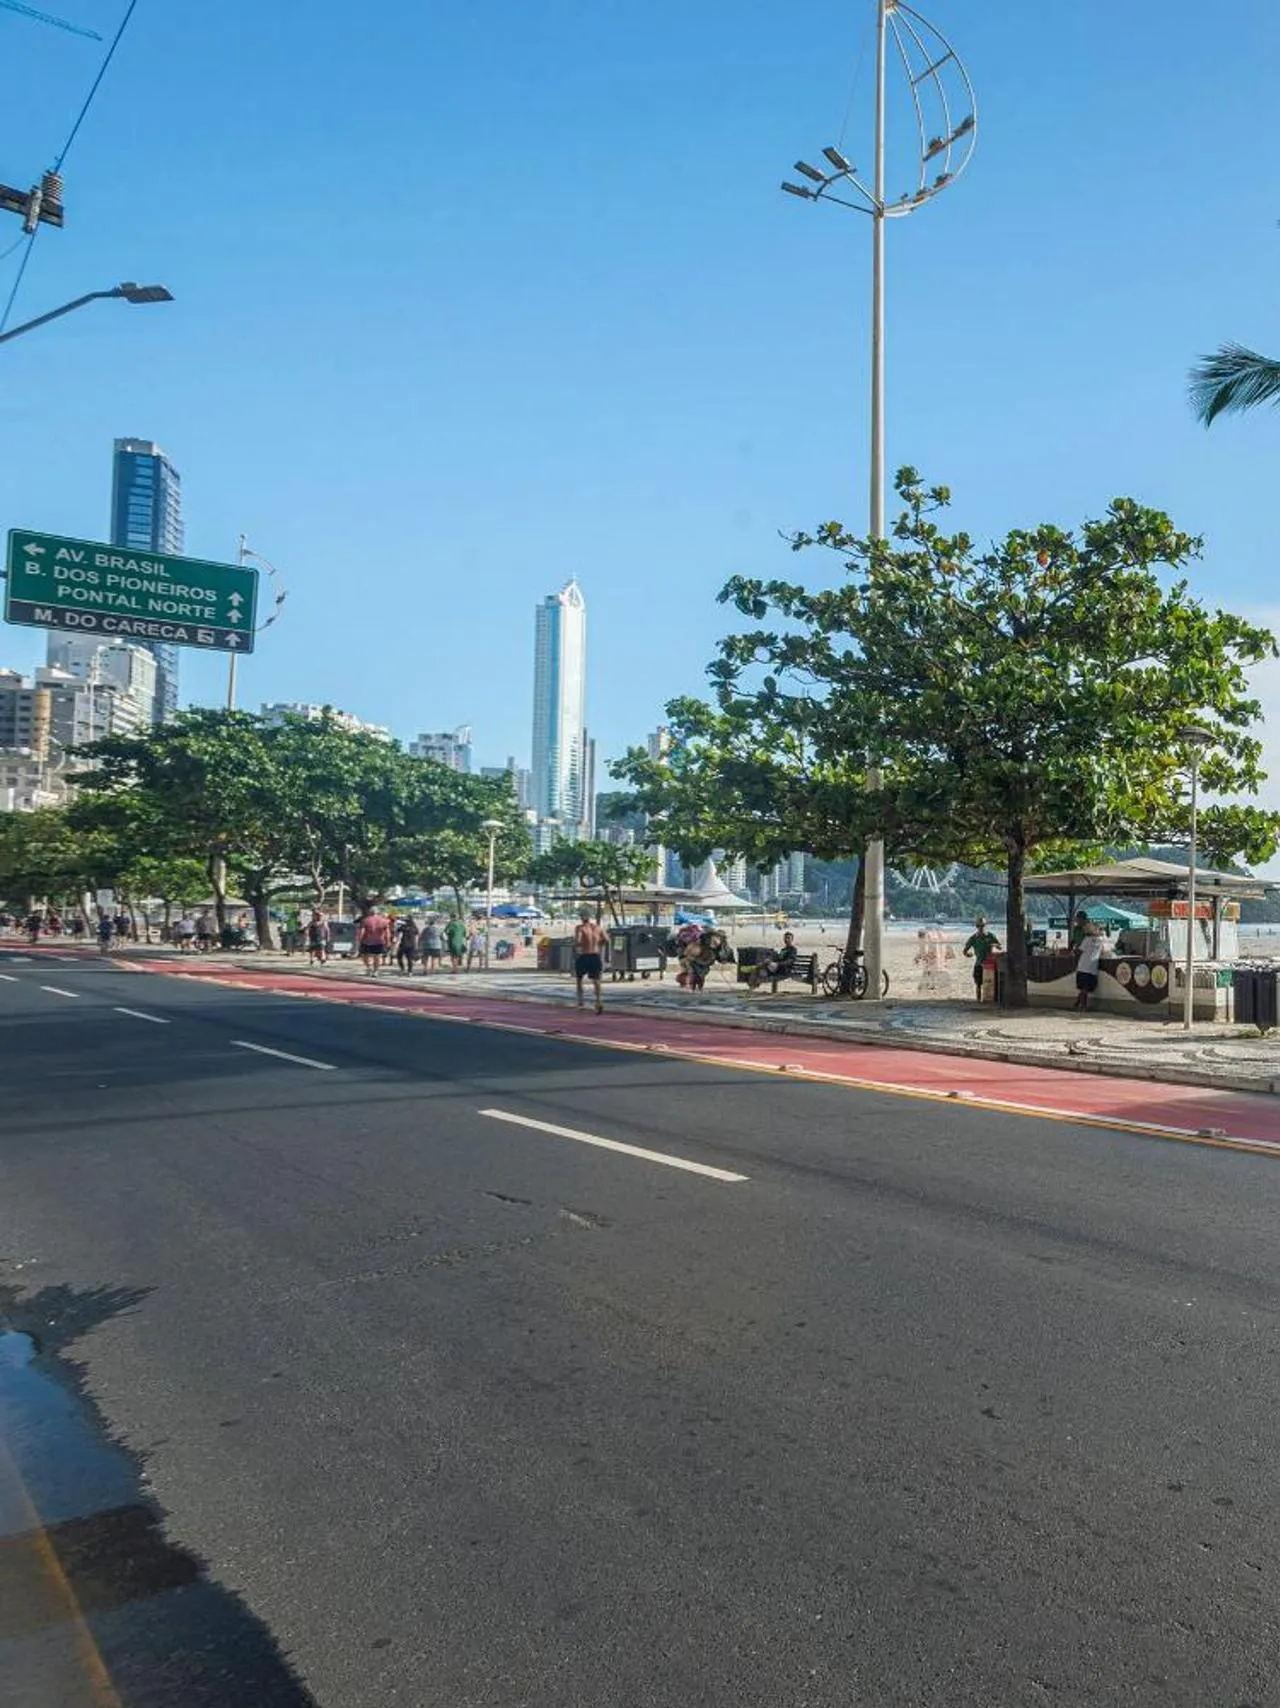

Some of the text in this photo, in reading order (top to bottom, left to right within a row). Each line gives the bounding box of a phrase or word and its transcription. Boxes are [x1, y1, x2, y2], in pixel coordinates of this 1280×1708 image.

[55, 548, 171, 577] AV. BRASIL
[25, 561, 217, 600] B. DOS PIONEIROS
[57, 585, 216, 618] PONTAL NORTE
[34, 608, 188, 639] M. DO CARECA
